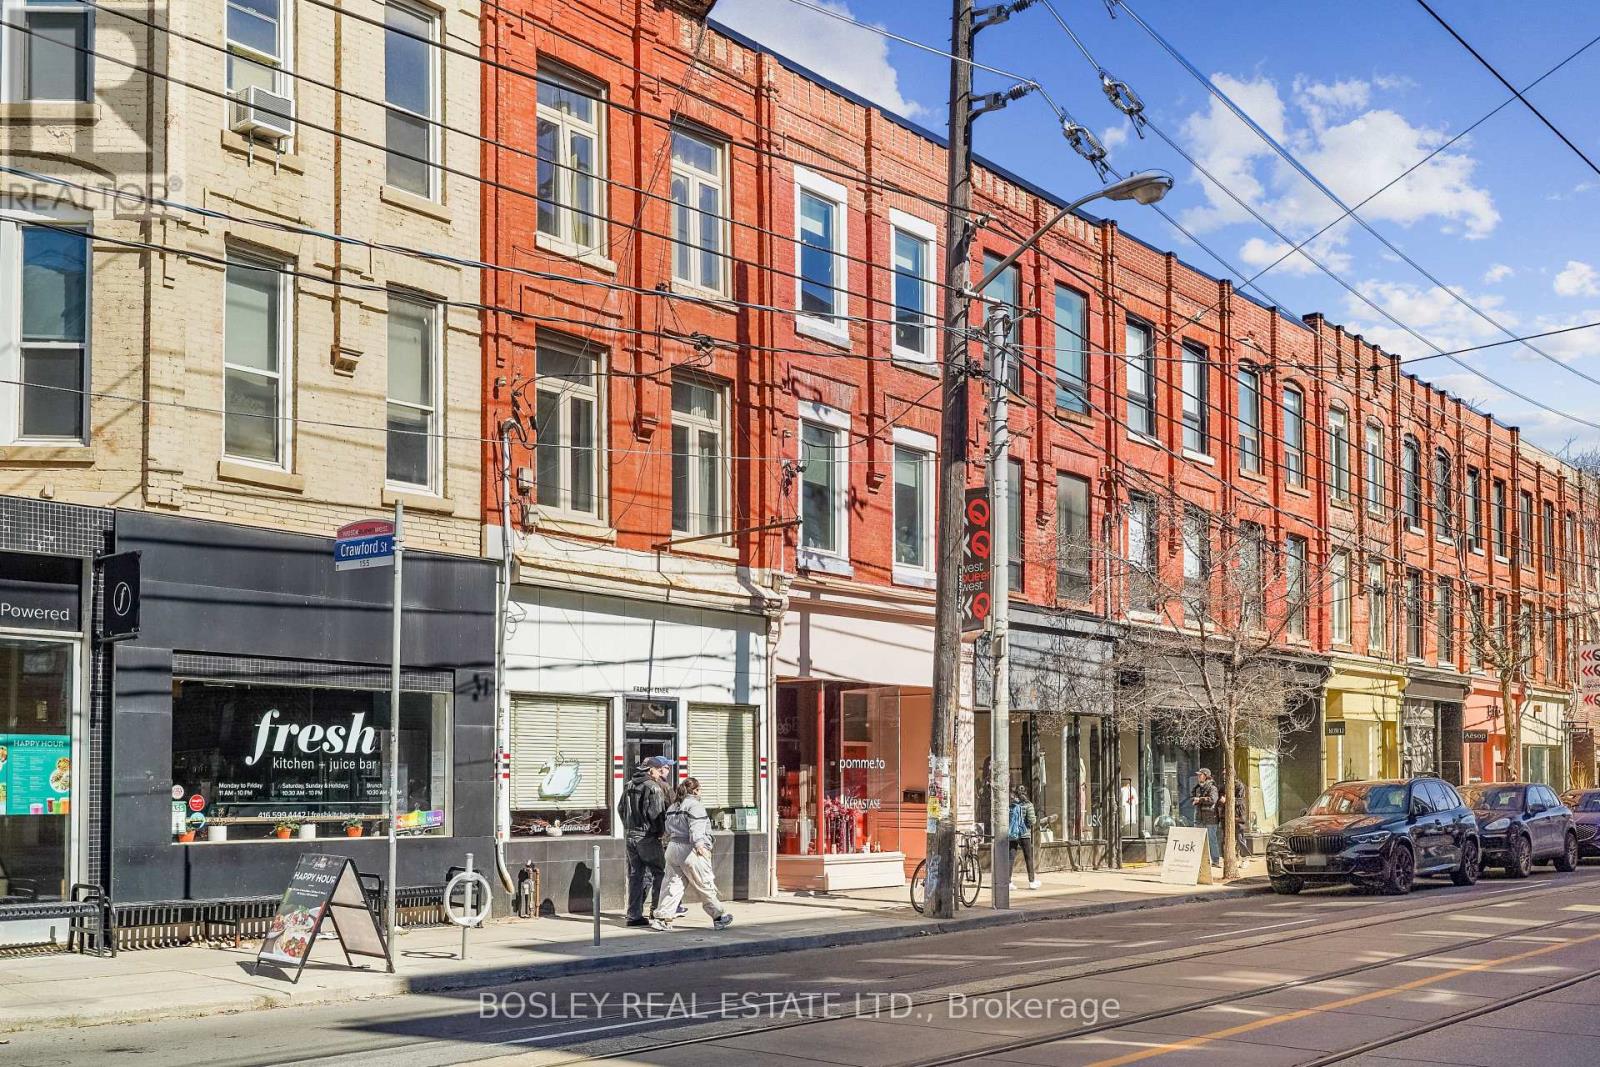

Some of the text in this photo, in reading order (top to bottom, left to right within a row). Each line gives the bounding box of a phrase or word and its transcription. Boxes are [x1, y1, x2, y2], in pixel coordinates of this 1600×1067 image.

[340, 540, 387, 557] Crawford St
[1, 602, 70, 620] Powered
[245, 708, 376, 765] fresh
[1464, 732, 1486, 741] Aesop
[13, 740, 40, 748] HAPPY
[273, 757, 314, 770] kitchen
[329, 757, 356, 772] juice
[359, 758, 377, 770] bar
[839, 758, 886, 772] pomme.to
[218, 782, 240, 790] Monday
[246, 782, 263, 790] Friday
[1172, 839, 1196, 852] Tusk
[293, 871, 337, 884] HAPPY HOUR
